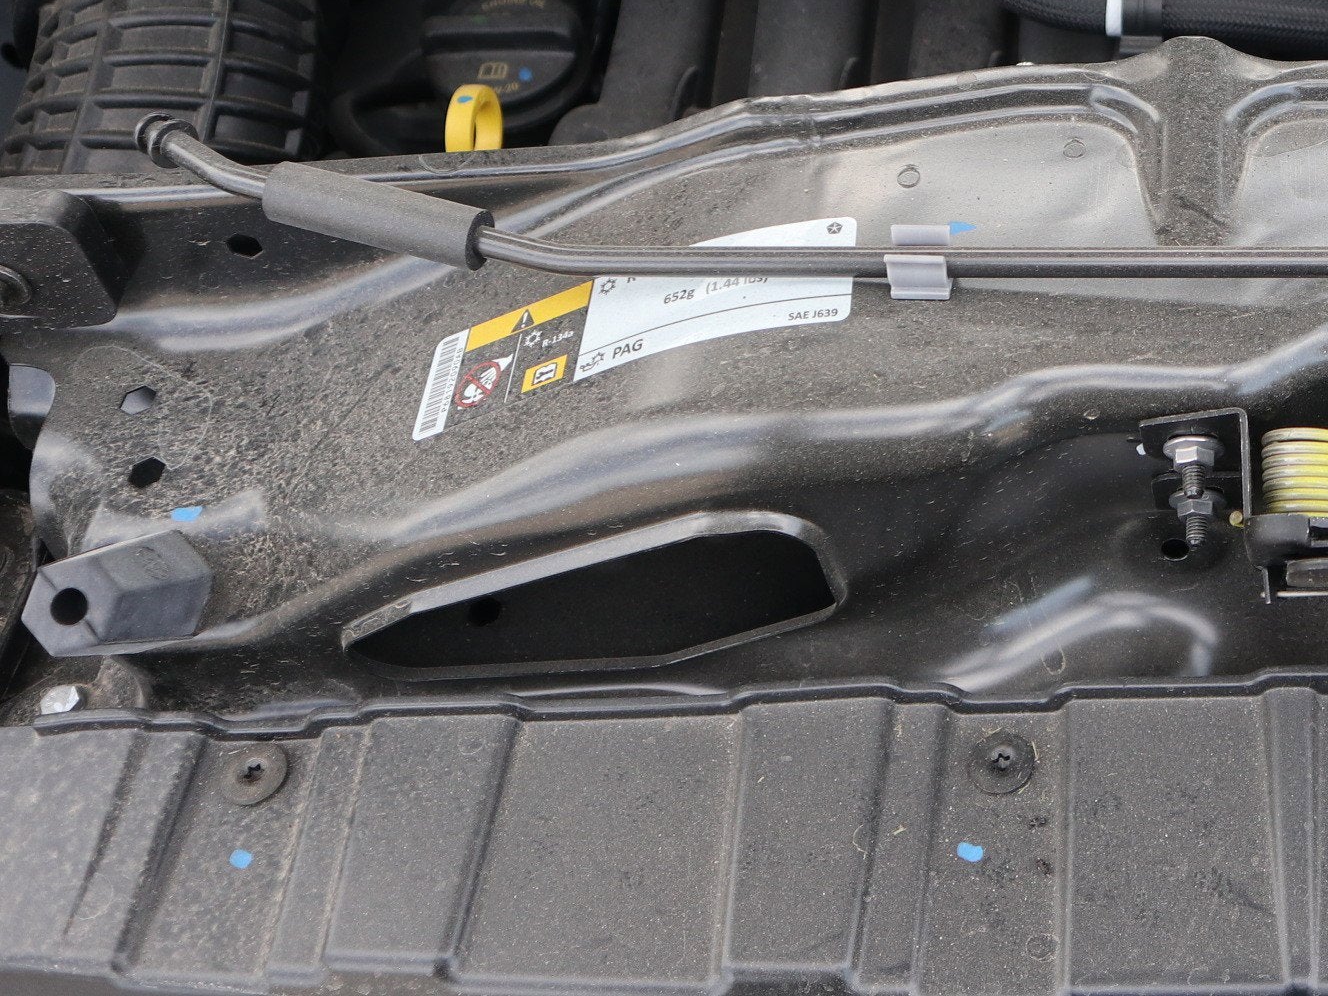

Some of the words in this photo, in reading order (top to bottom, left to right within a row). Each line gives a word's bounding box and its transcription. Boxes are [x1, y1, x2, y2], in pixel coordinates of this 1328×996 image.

[663, 288, 696, 305] 652g
[705, 277, 740, 295] (1.44
[787, 310, 810, 321] SAE
[812, 308, 838, 319] J639
[541, 329, 575, 348] R-134a
[612, 338, 644, 359] PAG
